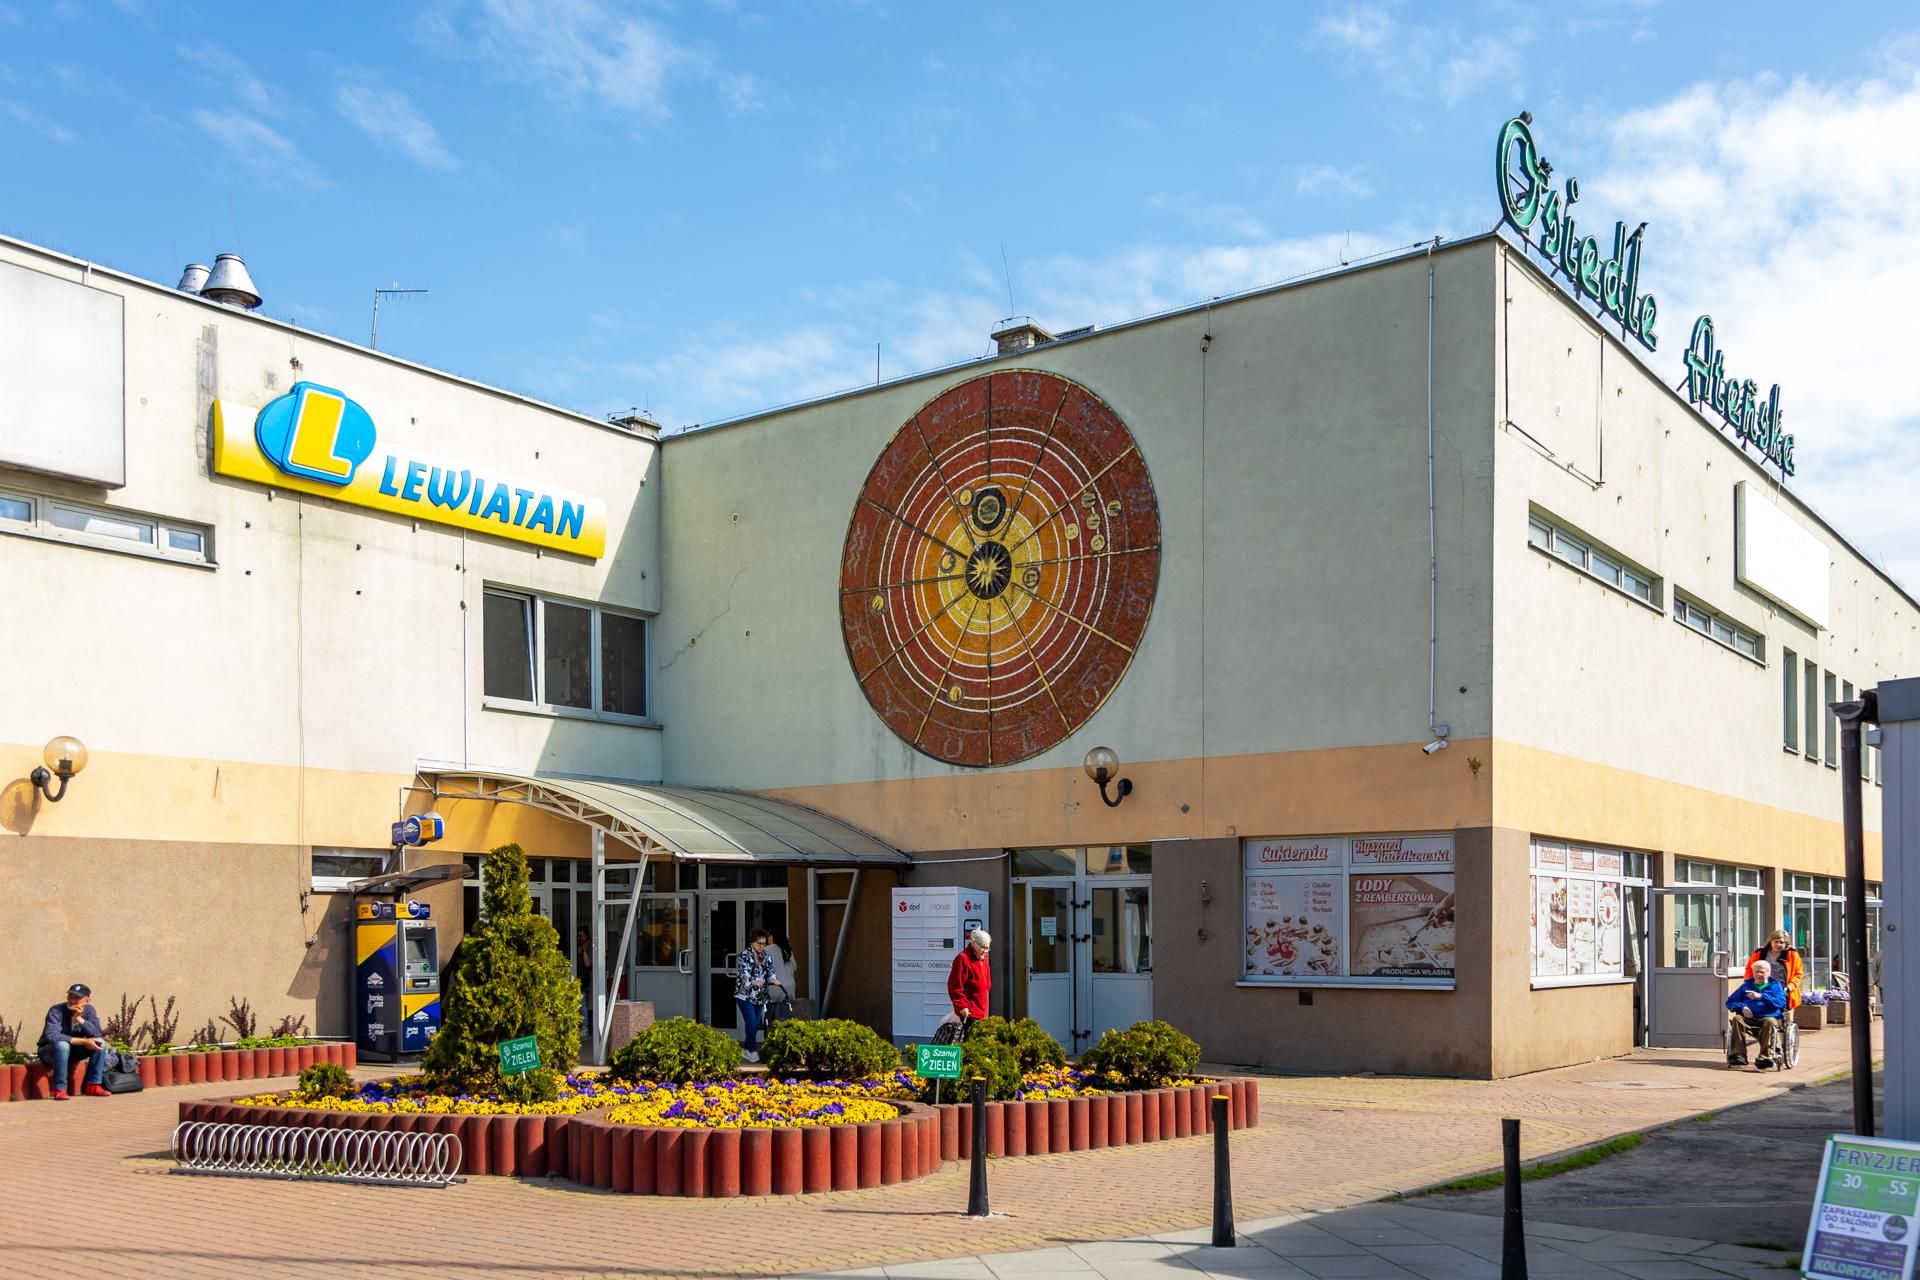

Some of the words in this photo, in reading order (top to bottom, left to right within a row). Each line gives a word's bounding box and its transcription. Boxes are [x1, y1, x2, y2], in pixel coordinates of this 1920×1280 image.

[1496, 117, 1657, 352] Osiedle
[378, 455, 585, 539] LEWIATAN
[1260, 845, 1328, 862] Cukiernia
[1355, 839, 1403, 855] Ryszard
[1375, 849, 1451, 863] Radzikowski
[1356, 880, 1392, 892] LODY
[1355, 893, 1362, 903] Z
[1363, 893, 1434, 903] REMBERTOWA
[908, 903, 921, 912] dpd
[972, 903, 982, 912] dpd
[1381, 967, 1420, 976] PRODUKCJA
[1421, 968, 1451, 977] WŁASNA
[512, 1041, 533, 1052] Szanuj
[932, 1048, 958, 1059] Szanuj
[1836, 1148, 1920, 1173] FRYZJER
[1842, 1173, 1862, 1189] 30
[1889, 1180, 1909, 1195] 55
[1823, 1205, 1883, 1222] ZAPRASZAMY
[1824, 1213, 1838, 1222] DO
